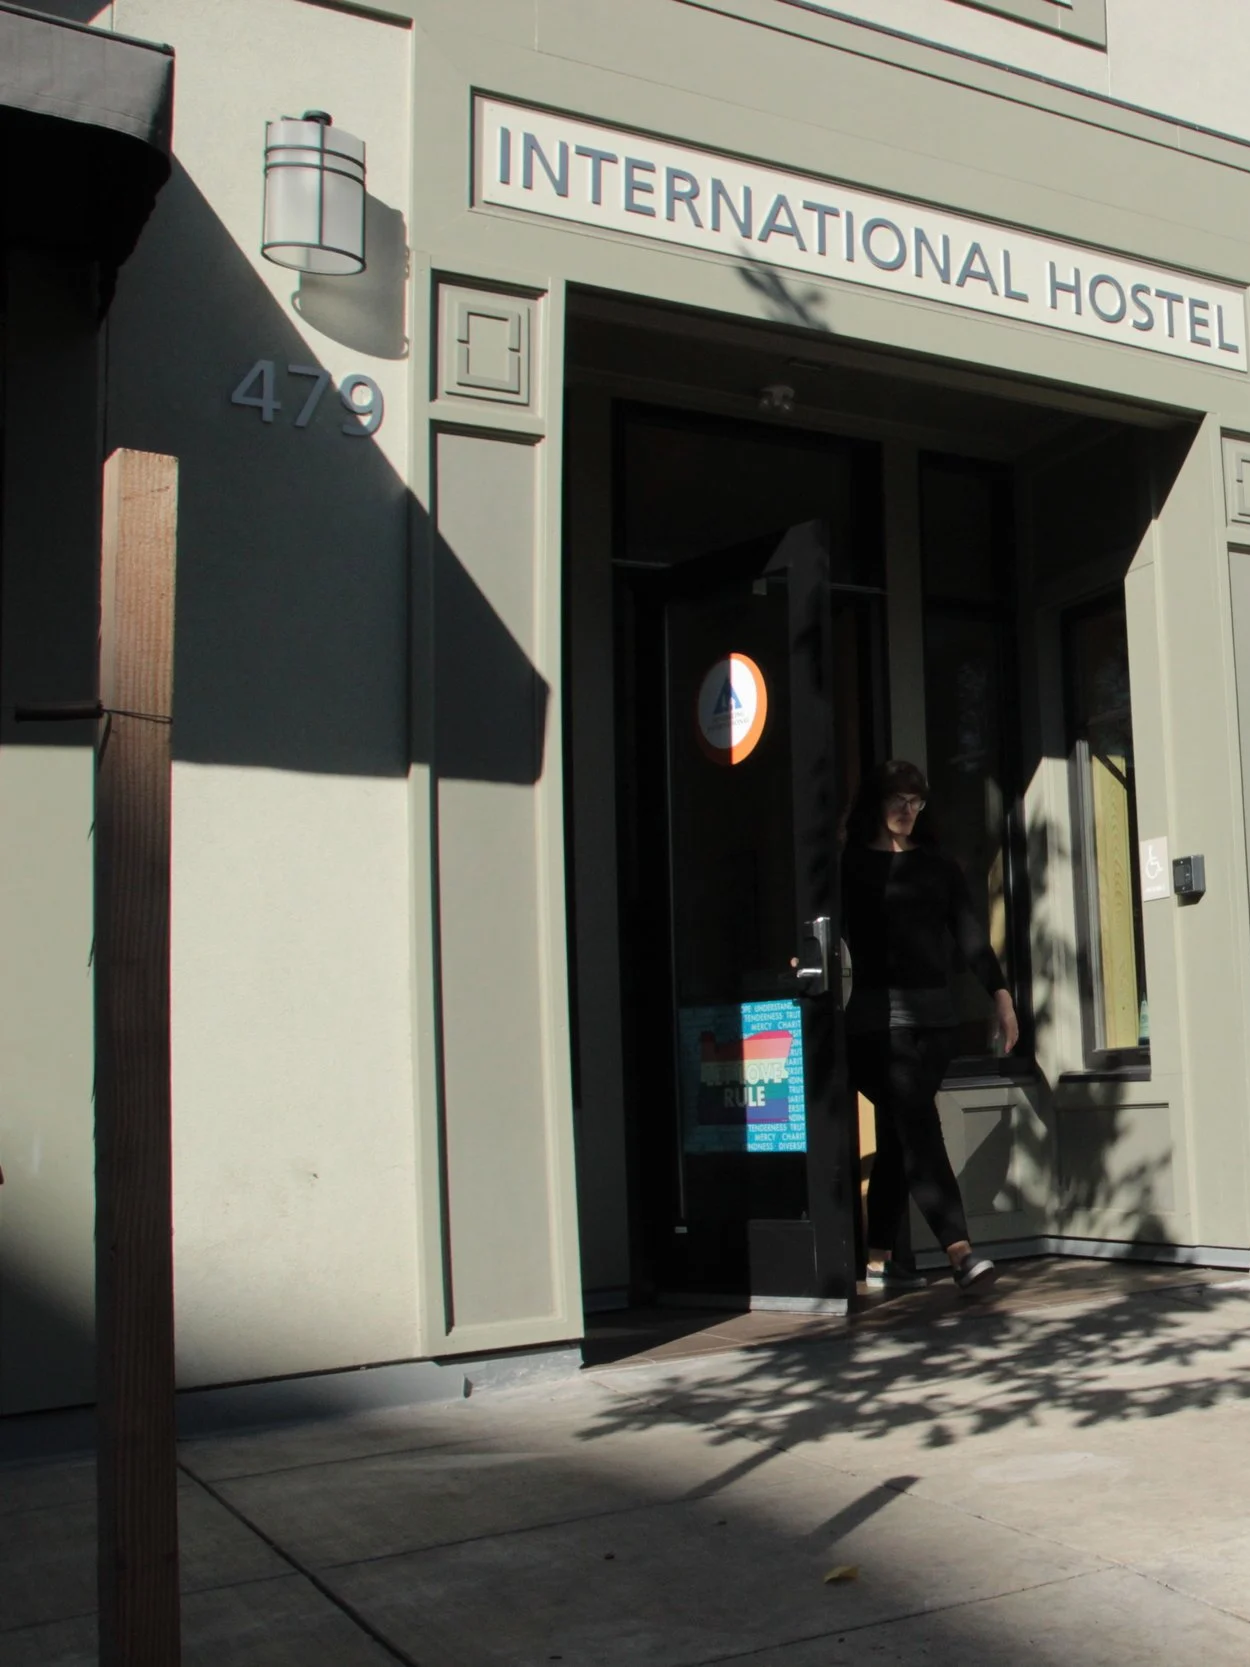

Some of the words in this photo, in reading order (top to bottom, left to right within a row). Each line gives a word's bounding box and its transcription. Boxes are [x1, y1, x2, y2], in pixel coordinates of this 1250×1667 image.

[498, 125, 1030, 303] INTERNATIONAL
[1049, 260, 1241, 354] HOSTEL
[230, 359, 385, 437] 479
[751, 1022, 772, 1031] MERCY
[736, 1064, 783, 1085] LOVE
[723, 1086, 766, 1107] RULE
[747, 1123, 787, 1132] TENDERNESS
[754, 1133, 776, 1141] MERCY
